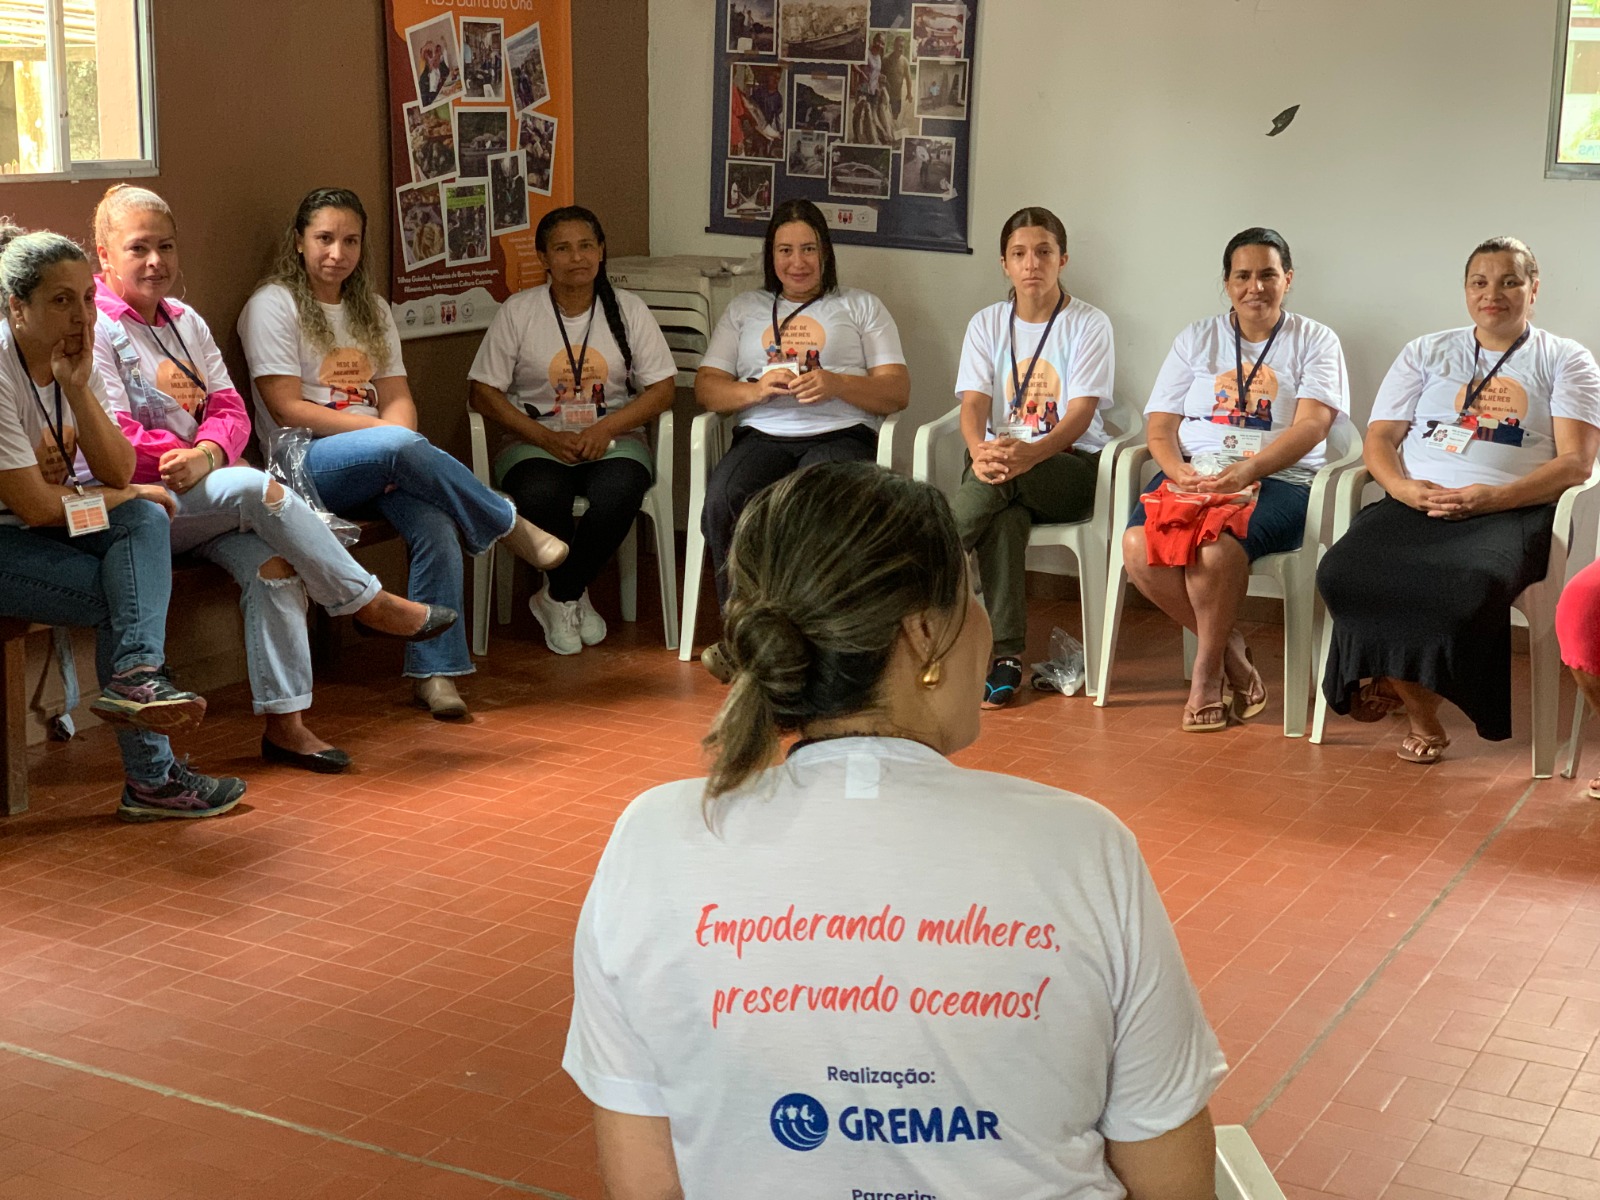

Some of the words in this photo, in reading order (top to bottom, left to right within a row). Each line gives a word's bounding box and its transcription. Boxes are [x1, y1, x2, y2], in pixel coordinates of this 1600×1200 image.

[695, 903, 906, 959] Empoderando
[917, 903, 1061, 953] mulheres,
[712, 974, 898, 1029] preservando
[910, 977, 1051, 1021] oceanos!
[827, 1066, 936, 1089] Realização:
[839, 1106, 1002, 1145] GREMAR
